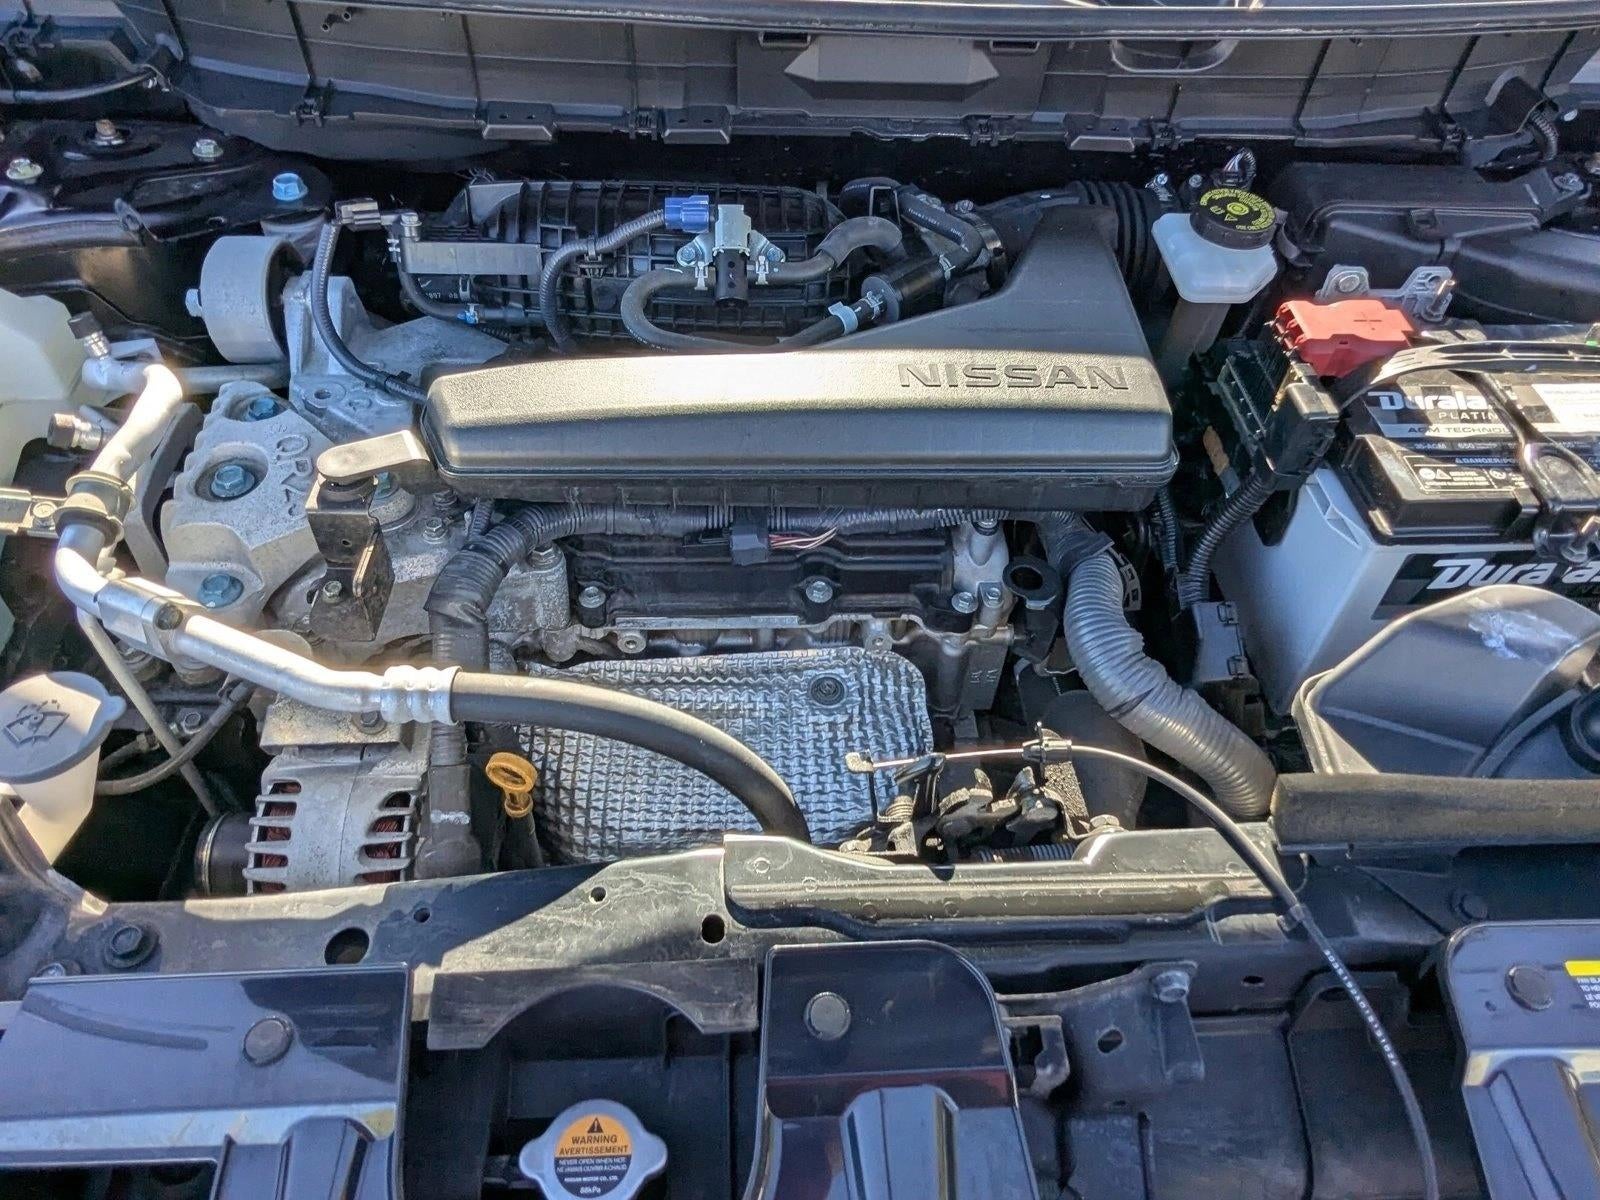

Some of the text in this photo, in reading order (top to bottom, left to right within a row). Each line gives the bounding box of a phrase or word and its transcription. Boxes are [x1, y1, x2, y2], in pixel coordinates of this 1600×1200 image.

[897, 363, 1129, 390] NISSAN
[1367, 391, 1494, 410] Durala
[1438, 411, 1499, 420] PLATIN
[1407, 426, 1511, 434] AGM TECHNOL
[571, 1135, 617, 1144] WARNING
[559, 1145, 628, 1155] AVERTISSEMENT
